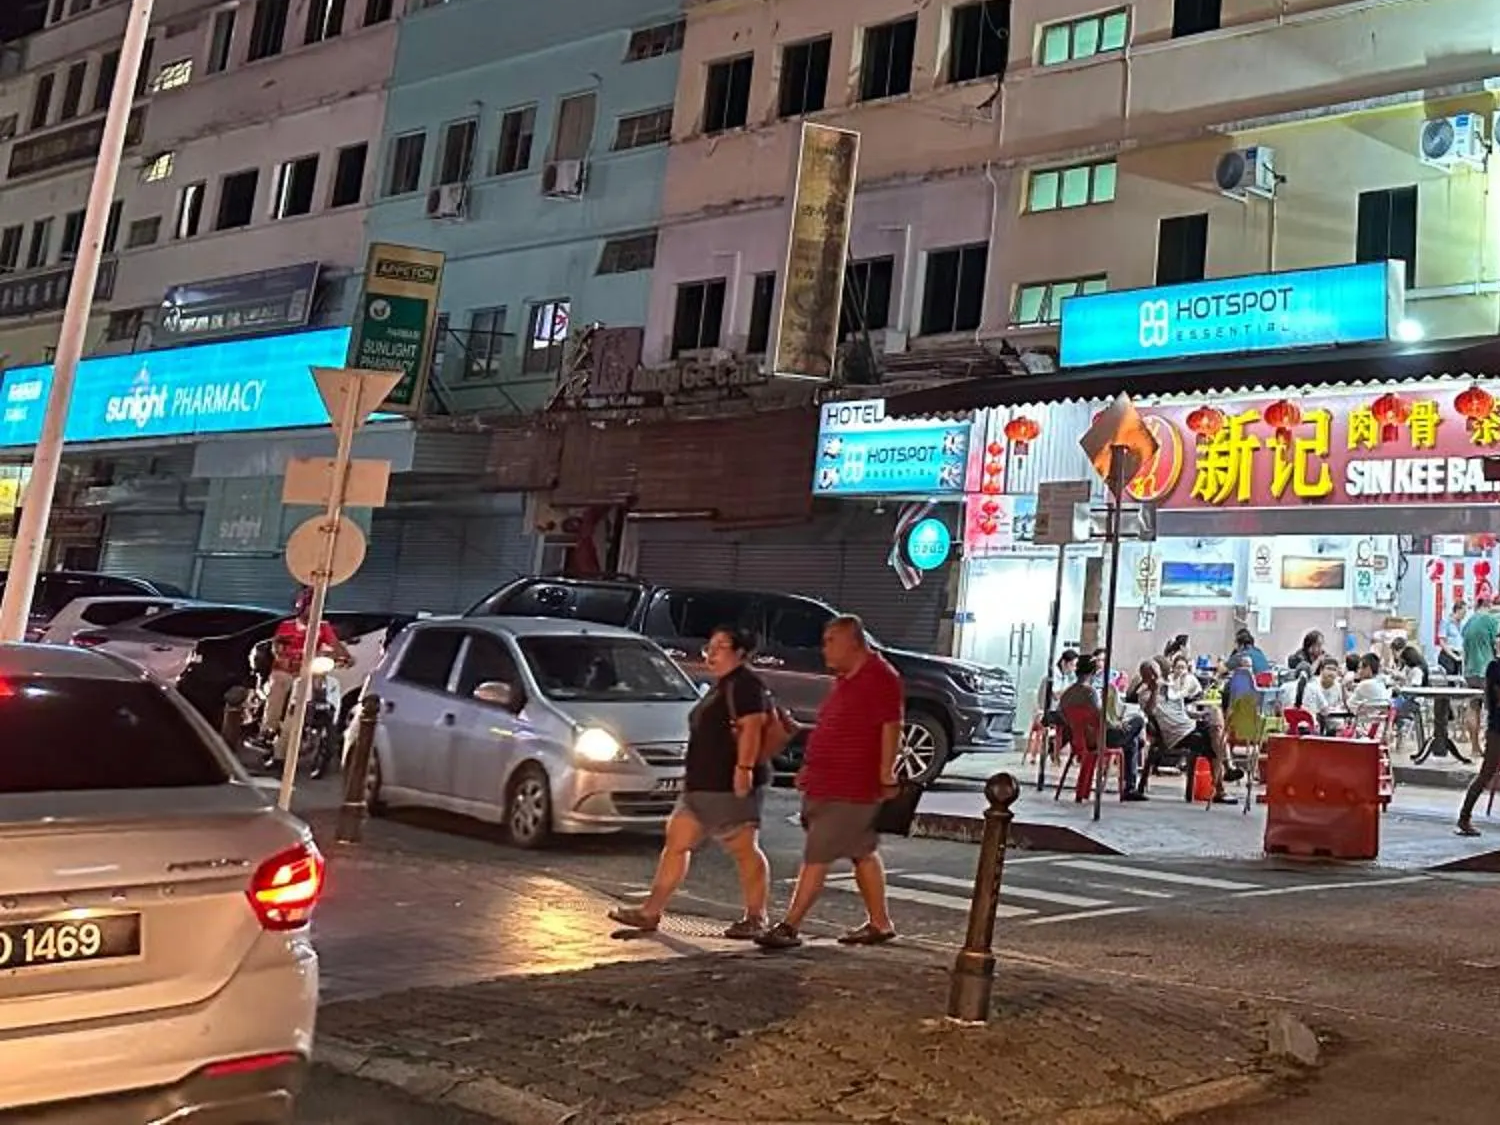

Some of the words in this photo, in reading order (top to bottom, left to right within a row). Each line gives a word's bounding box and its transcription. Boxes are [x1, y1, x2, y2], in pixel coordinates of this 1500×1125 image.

[1176, 287, 1294, 320] HOTSPOT
[1176, 322, 1290, 342] ESSENTIAL
[171, 379, 266, 418] PHARMACY
[826, 405, 885, 425] HOTEL
[867, 446, 938, 464] HOTSPOT
[1190, 409, 1334, 503] 新记
[1345, 458, 1393, 496] SIN
[1394, 457, 1446, 494] KEE
[23, 924, 101, 961] 1469
